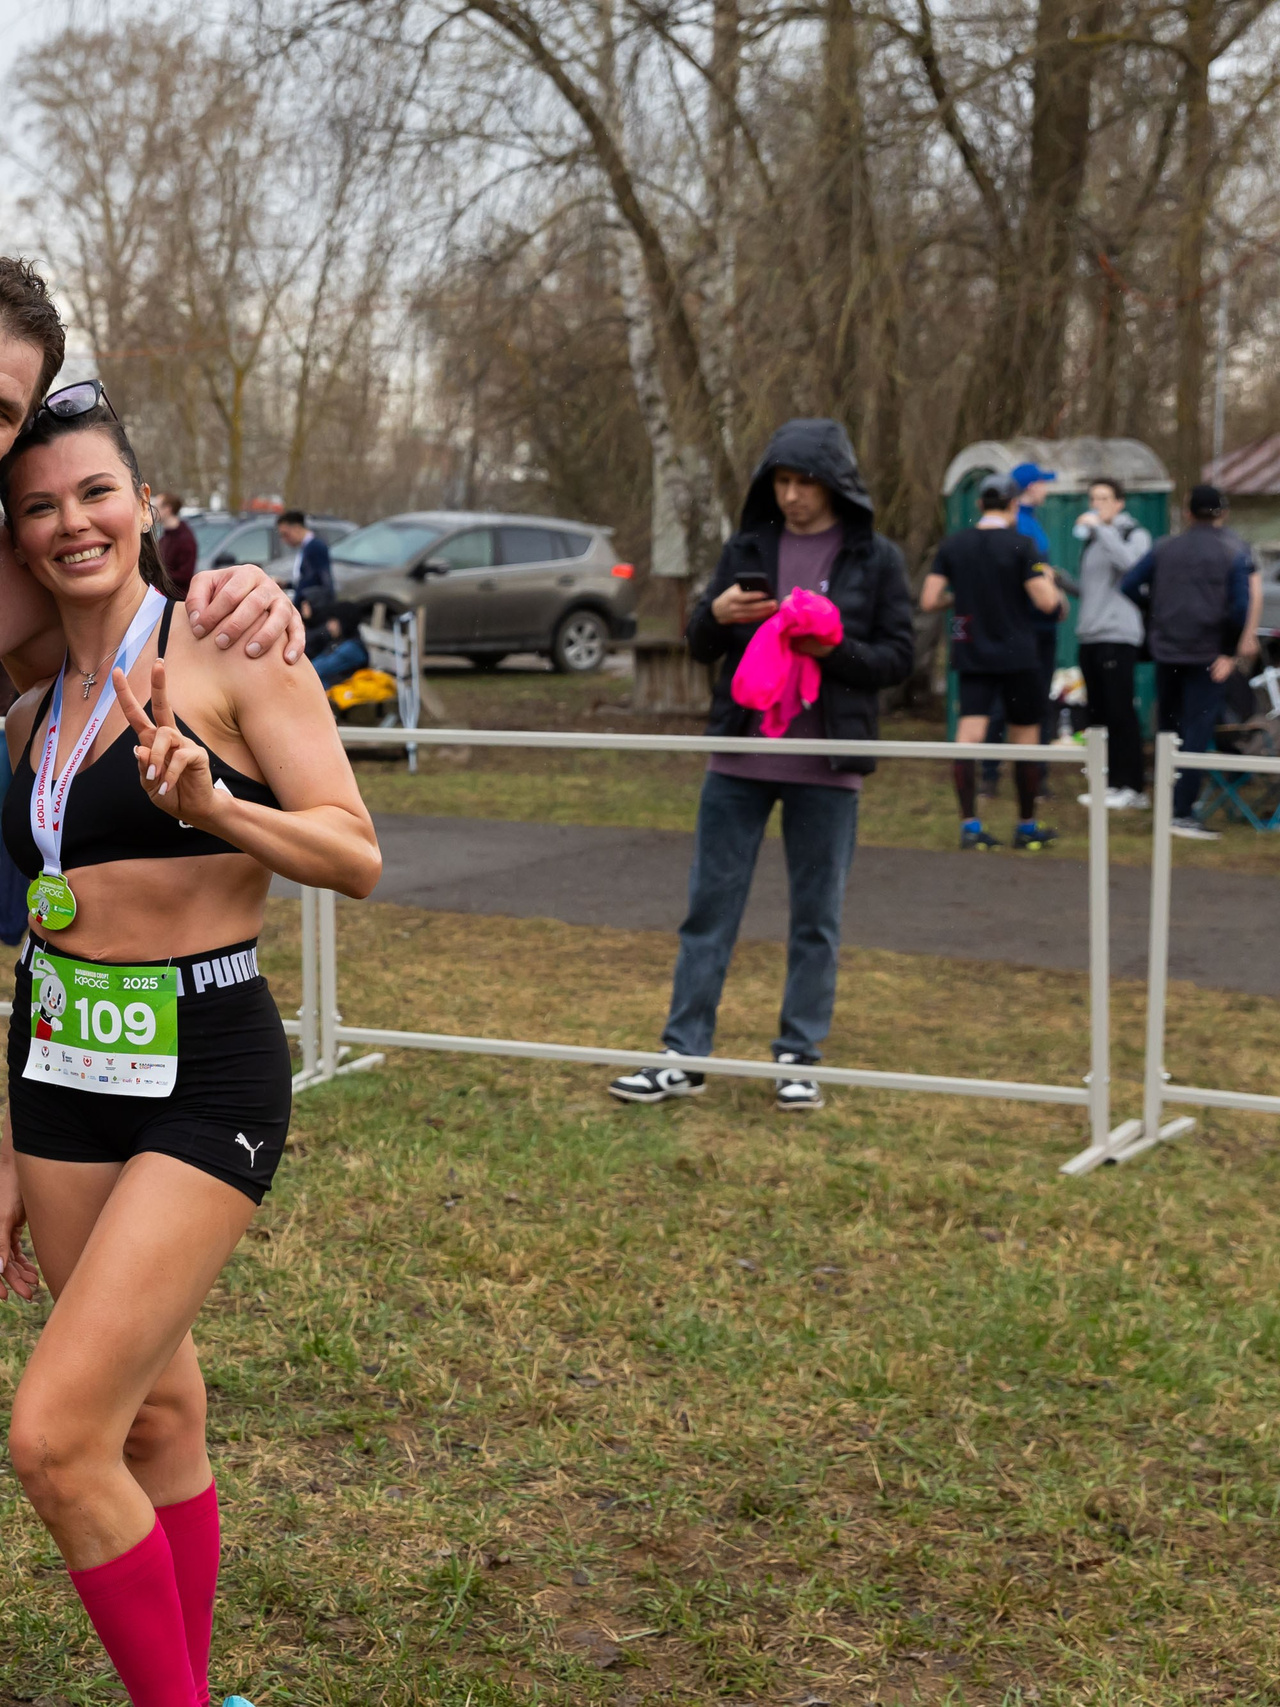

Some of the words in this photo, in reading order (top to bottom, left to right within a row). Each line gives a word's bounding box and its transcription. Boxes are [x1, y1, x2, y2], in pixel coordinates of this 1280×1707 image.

[37, 739, 53, 796] КАЛАШНИКОВ
[54, 747, 84, 814] КАЛАШНИКОВ
[81, 717, 100, 746] СПОРТ
[36, 798, 46, 830] СПОРТ
[74, 975, 110, 990] КРОСС
[122, 977, 158, 990] 2025
[74, 997, 157, 1046] 109
